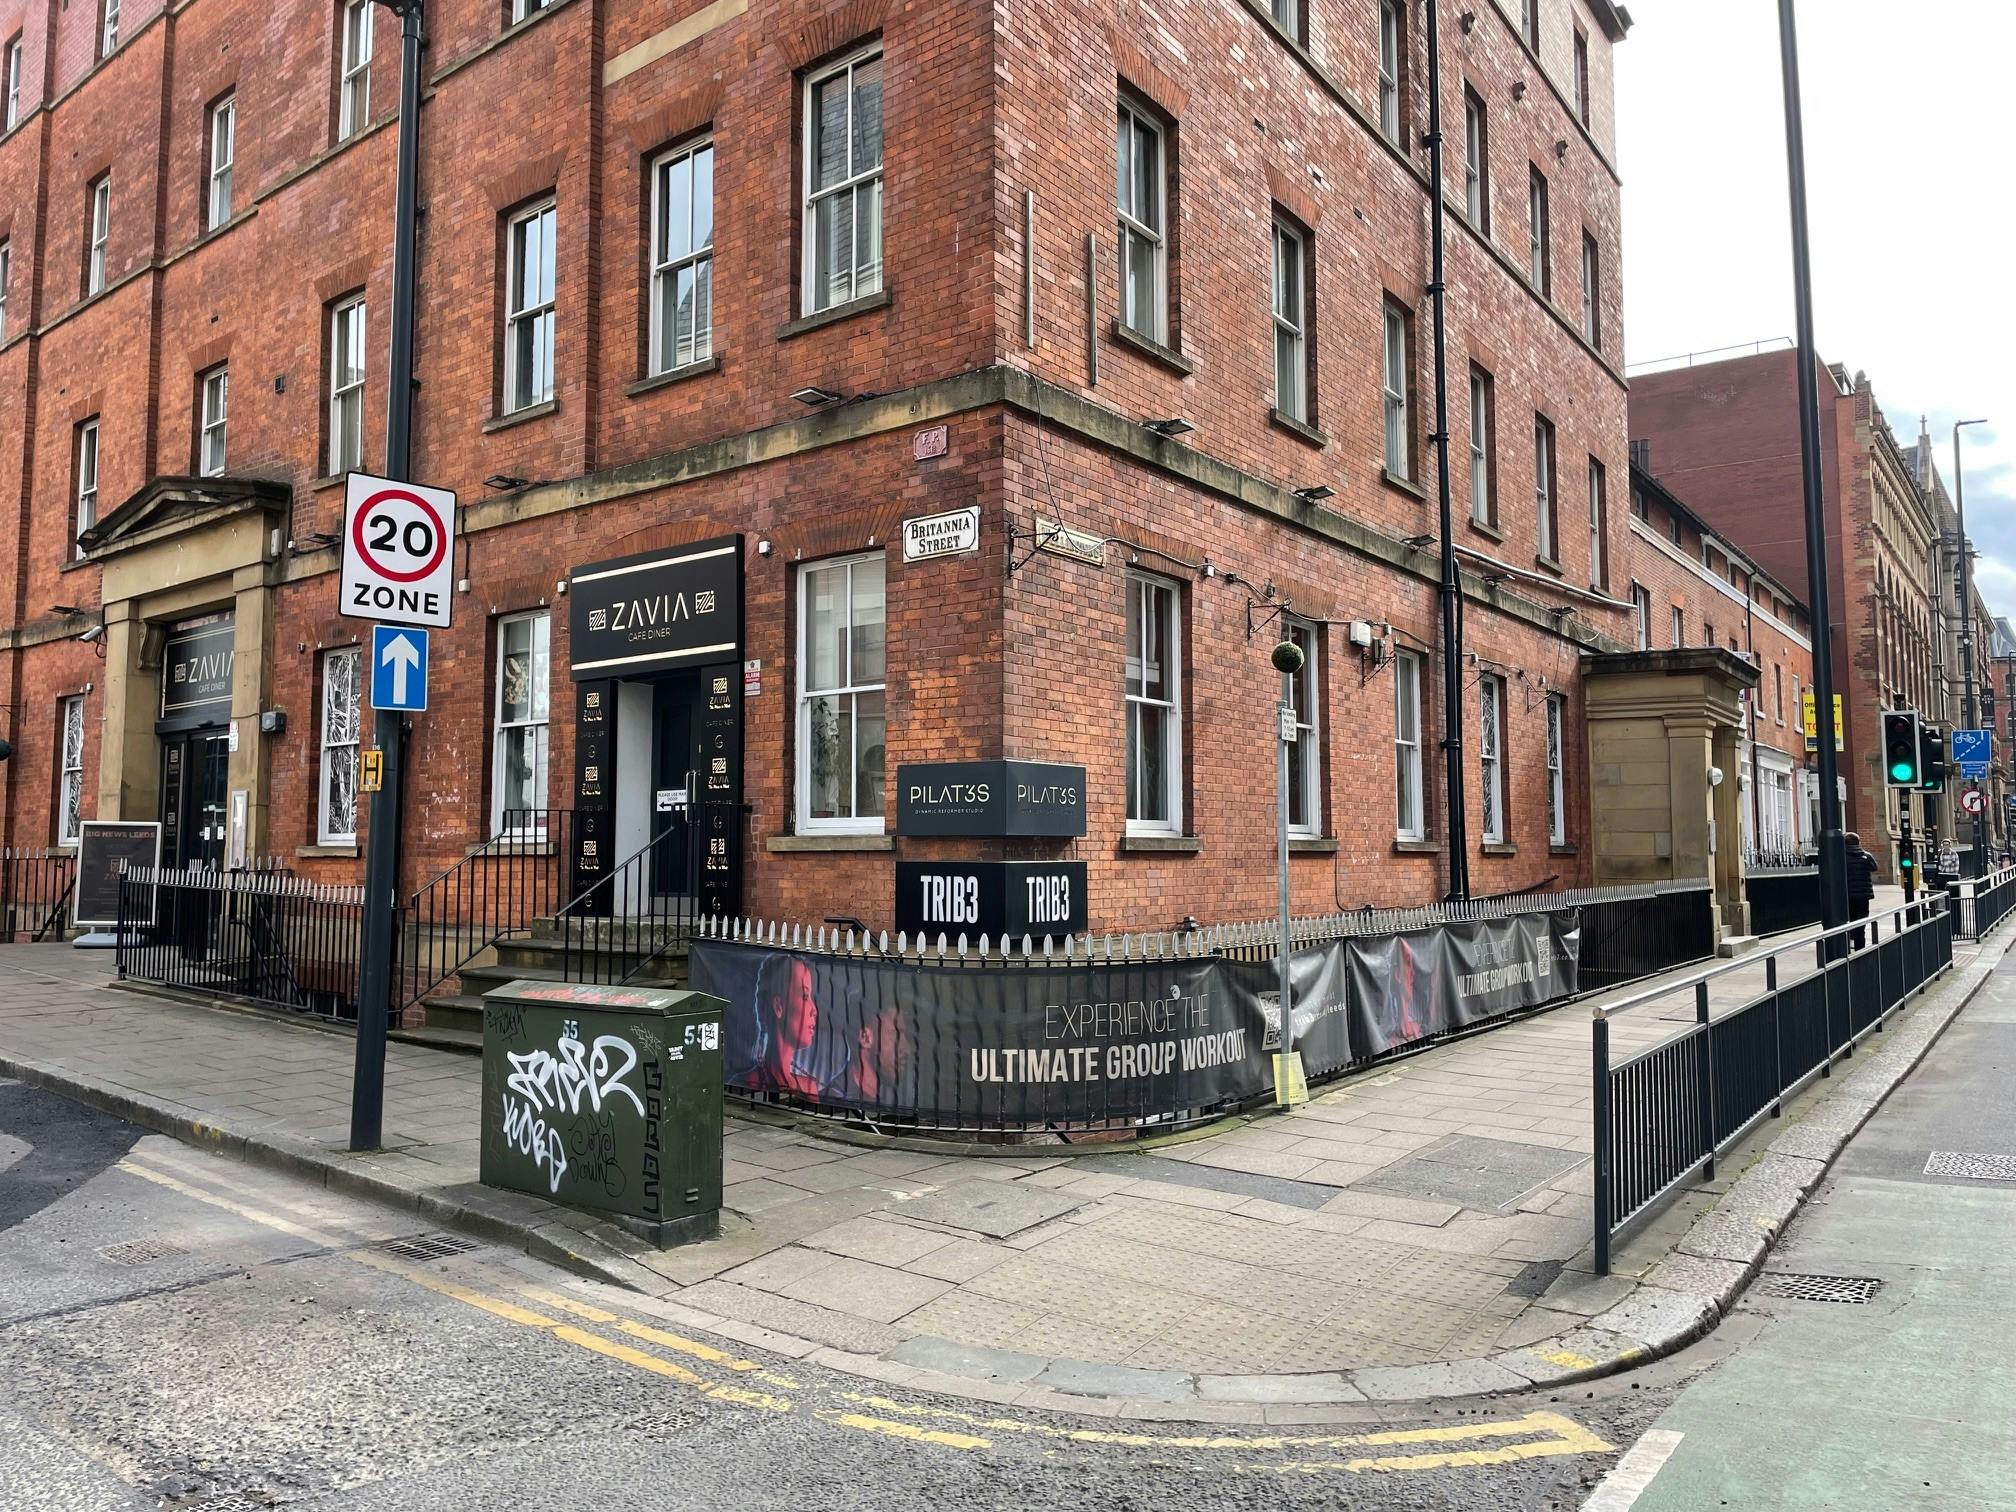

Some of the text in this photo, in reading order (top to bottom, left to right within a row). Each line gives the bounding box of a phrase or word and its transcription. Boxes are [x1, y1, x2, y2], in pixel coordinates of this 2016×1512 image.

[369, 514, 433, 557] 20
[911, 517, 970, 540] BRITANNIA
[918, 535, 960, 554] STREET
[353, 583, 439, 615] ZONE
[611, 592, 689, 631] ZAVIA
[628, 627, 671, 642] CAFE DINER
[188, 650, 235, 684] ZAVIA
[709, 695, 731, 704] ZAVIA
[583, 709, 602, 718] ZAVIA
[363, 753, 380, 785] H
[708, 775, 729, 785] ZAVIA
[582, 783, 601, 793] ZAVIA
[129, 831, 155, 839] LEEDS
[580, 857, 599, 866] ZAVIA
[920, 875, 979, 923] TRIB3
[1026, 875, 1070, 923] TRIB3
[1457, 970, 1490, 998] ULTIMATE
[1045, 993, 1209, 1039] EXPERIENCE THE
[562, 1019, 579, 1040] 55
[971, 1028, 1247, 1083] ULTIMATE GROUP WORKOUT
